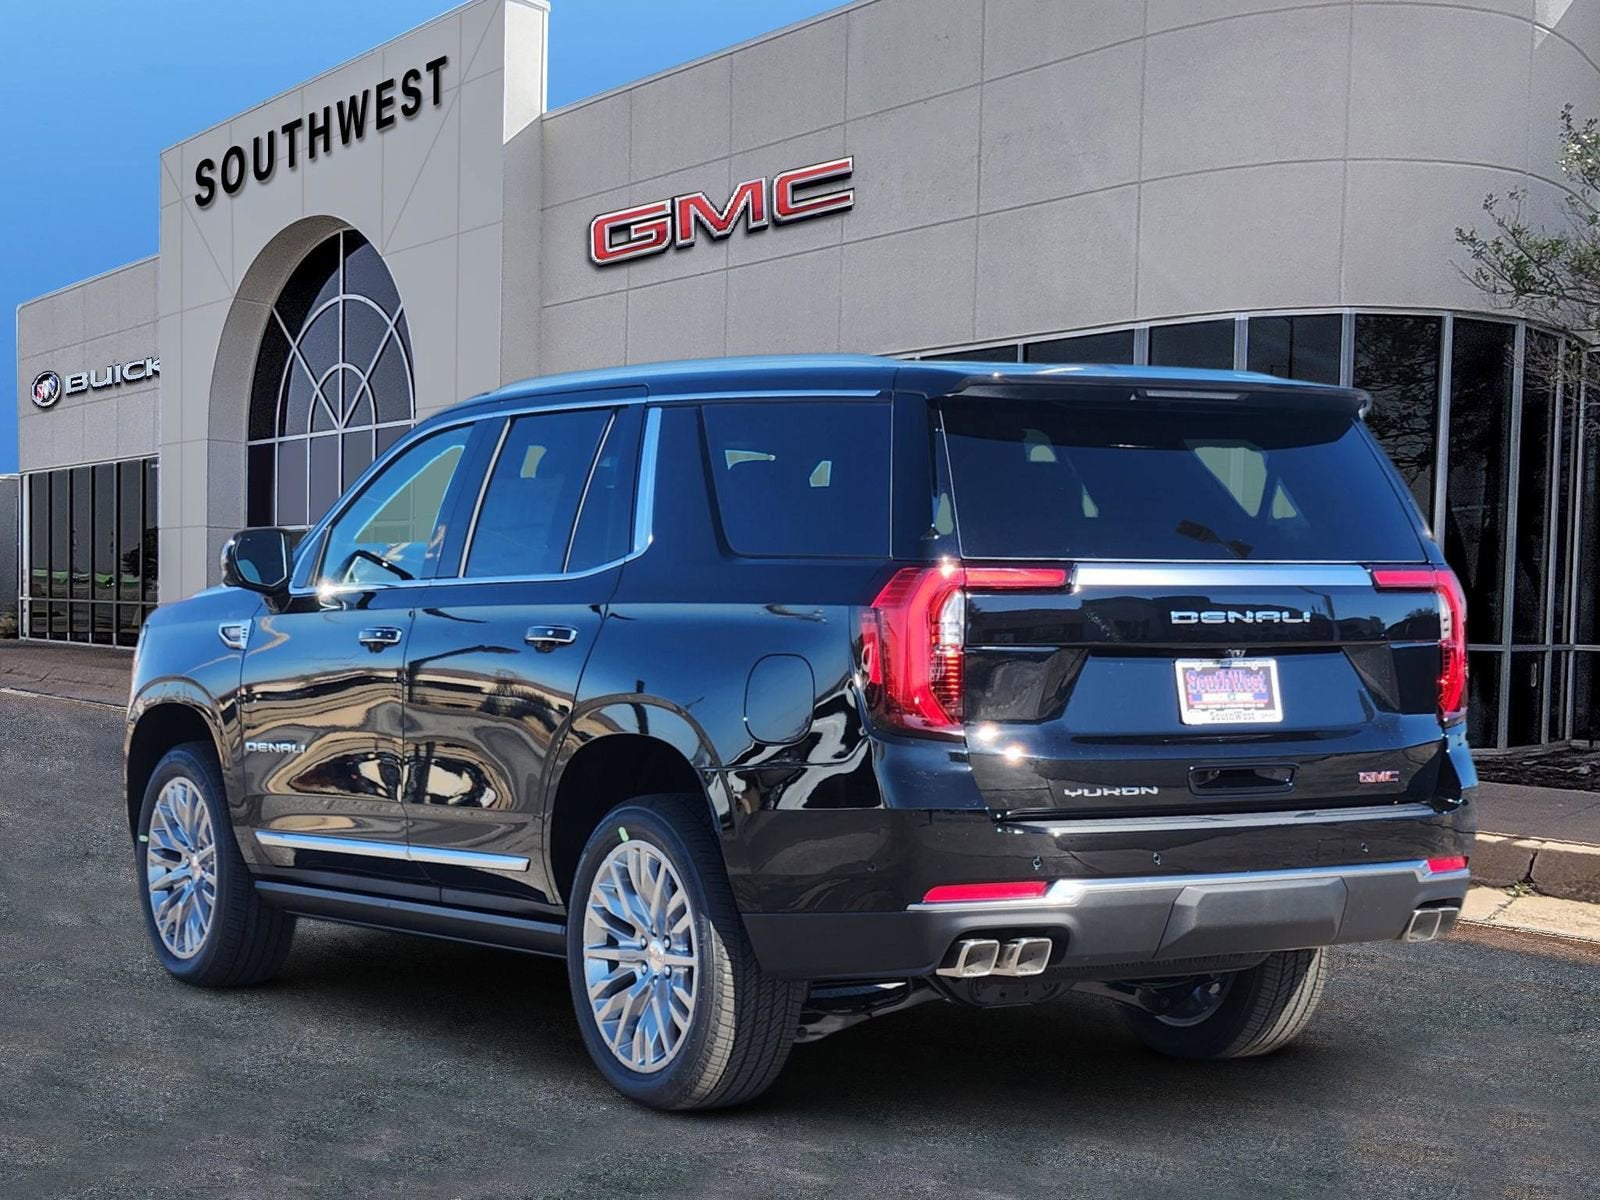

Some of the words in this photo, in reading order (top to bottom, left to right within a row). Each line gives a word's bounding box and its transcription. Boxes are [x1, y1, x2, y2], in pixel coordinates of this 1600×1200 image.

[194, 55, 448, 208] SOUTHWEST
[589, 156, 854, 266] GMC
[1170, 610, 1312, 625] DENALI
[245, 741, 306, 753] DENALI
[1359, 770, 1400, 783] GMC
[1063, 786, 1159, 798] YUKON
